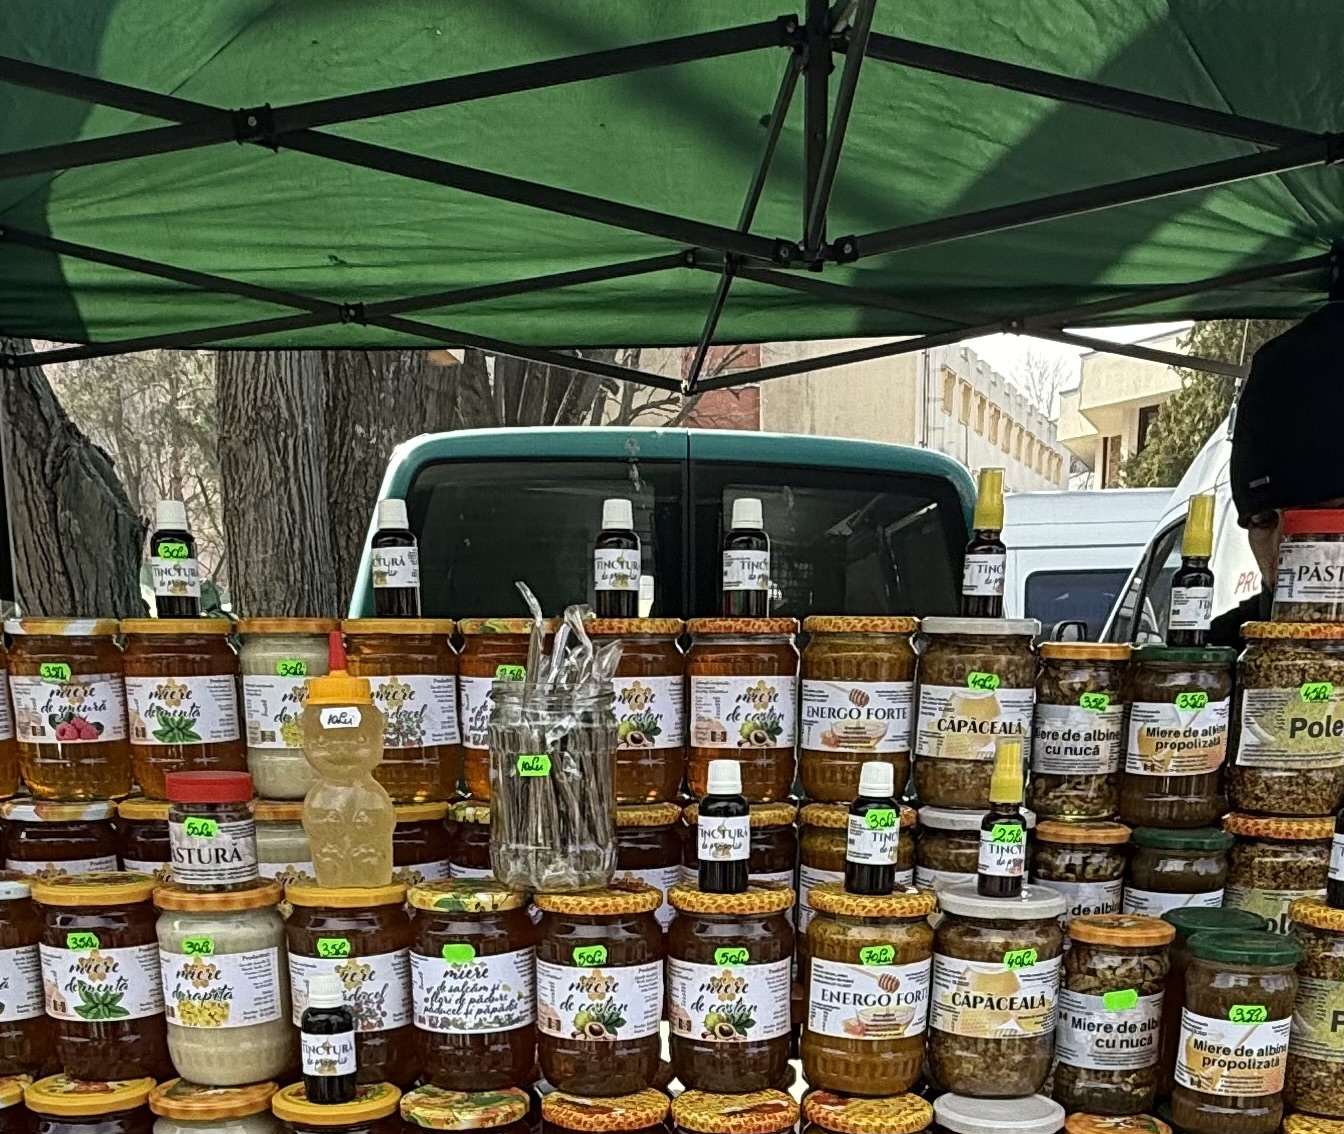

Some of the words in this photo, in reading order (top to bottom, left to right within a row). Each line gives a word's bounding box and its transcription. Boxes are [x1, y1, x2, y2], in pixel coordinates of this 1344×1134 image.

[807, 706, 861, 720] ENERGO
[867, 706, 908, 720] FORTE
[1062, 728, 1081, 742] de
[1146, 725, 1180, 739] Miere
[1183, 727, 1201, 739] de
[1045, 744, 1062, 756] cu
[821, 988, 891, 1007] ENERGO
[1072, 1016, 1114, 1031] Miere
[1117, 1020, 1137, 1034] de
[1095, 1035, 1112, 1049] cu
[1115, 1032, 1153, 1049] nucă
[1193, 1039, 1229, 1056] Miere
[1232, 1043, 1253, 1056] de
